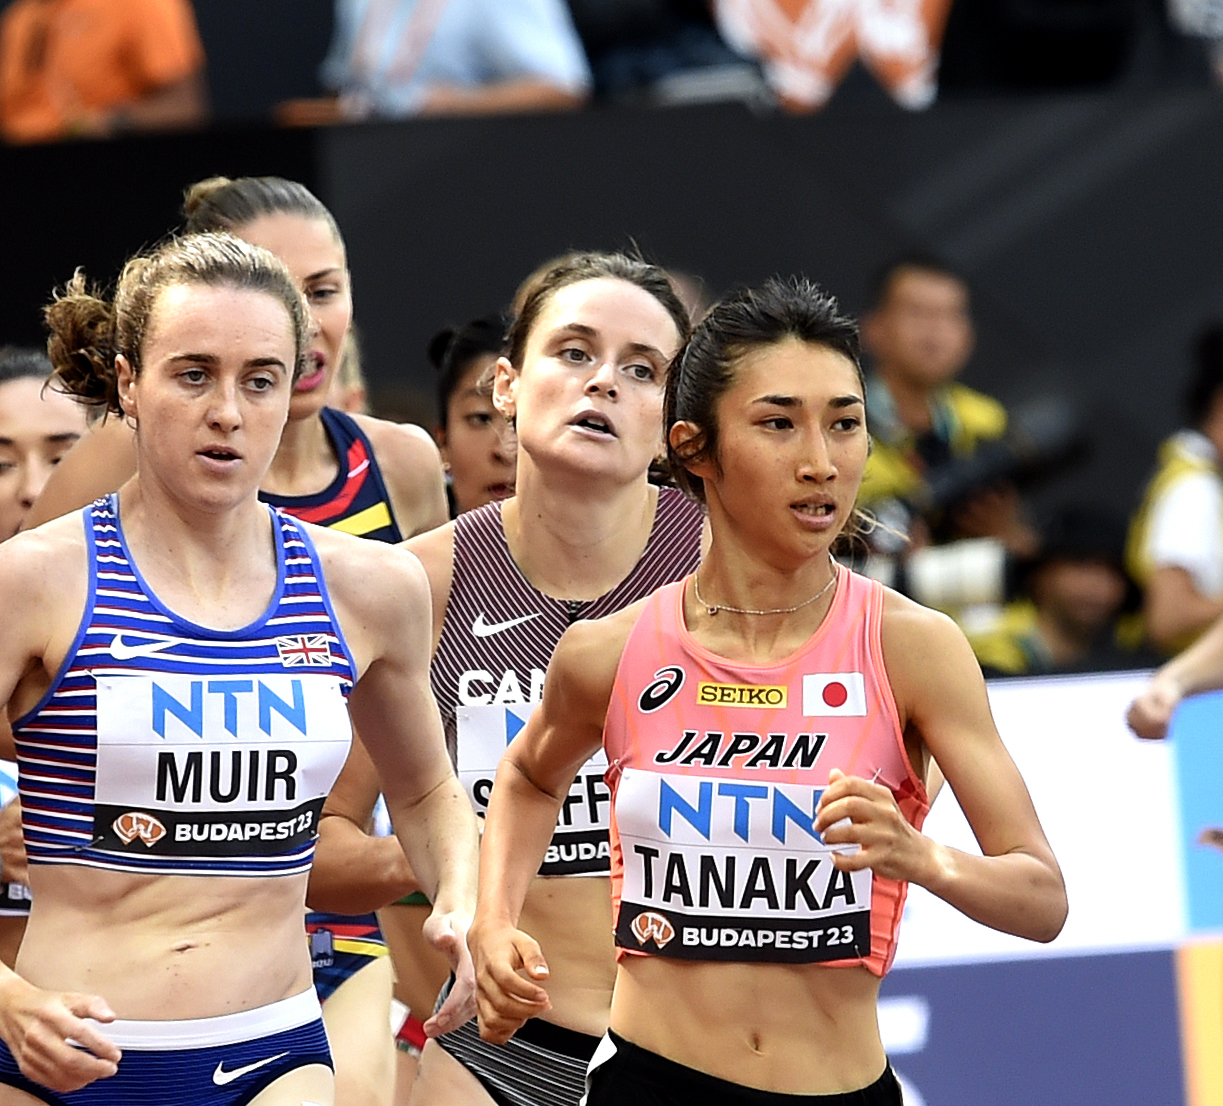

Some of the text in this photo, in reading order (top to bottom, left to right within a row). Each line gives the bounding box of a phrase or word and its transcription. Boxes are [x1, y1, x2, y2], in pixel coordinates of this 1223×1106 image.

[152, 680, 307, 739] NTN
[700, 686, 784, 705] SEIKO
[654, 731, 828, 769] JAPAN
[155, 750, 298, 803] MUIR
[175, 810, 314, 842] BUDAPEST 23
[659, 778, 826, 846] NTN
[633, 845, 857, 911] TANAKA
[682, 926, 854, 949] BUDAPEST 23
